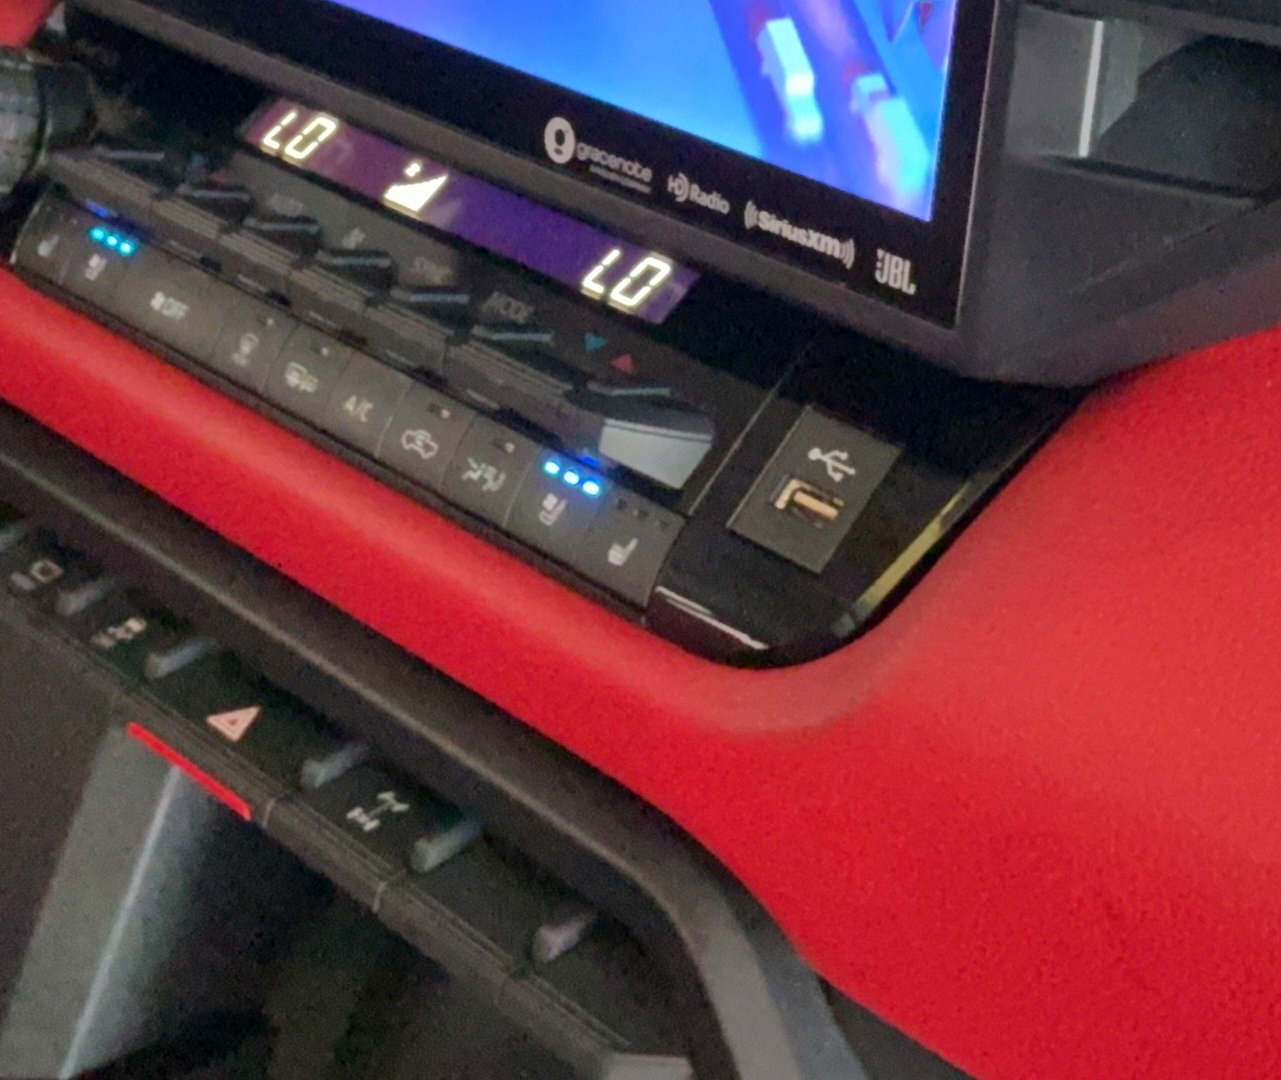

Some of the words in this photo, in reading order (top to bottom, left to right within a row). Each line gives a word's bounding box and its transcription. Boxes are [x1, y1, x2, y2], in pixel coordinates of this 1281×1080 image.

[576, 141, 653, 183] gracenote
[689, 183, 731, 214] Radio
[874, 248, 916, 295] JBL
